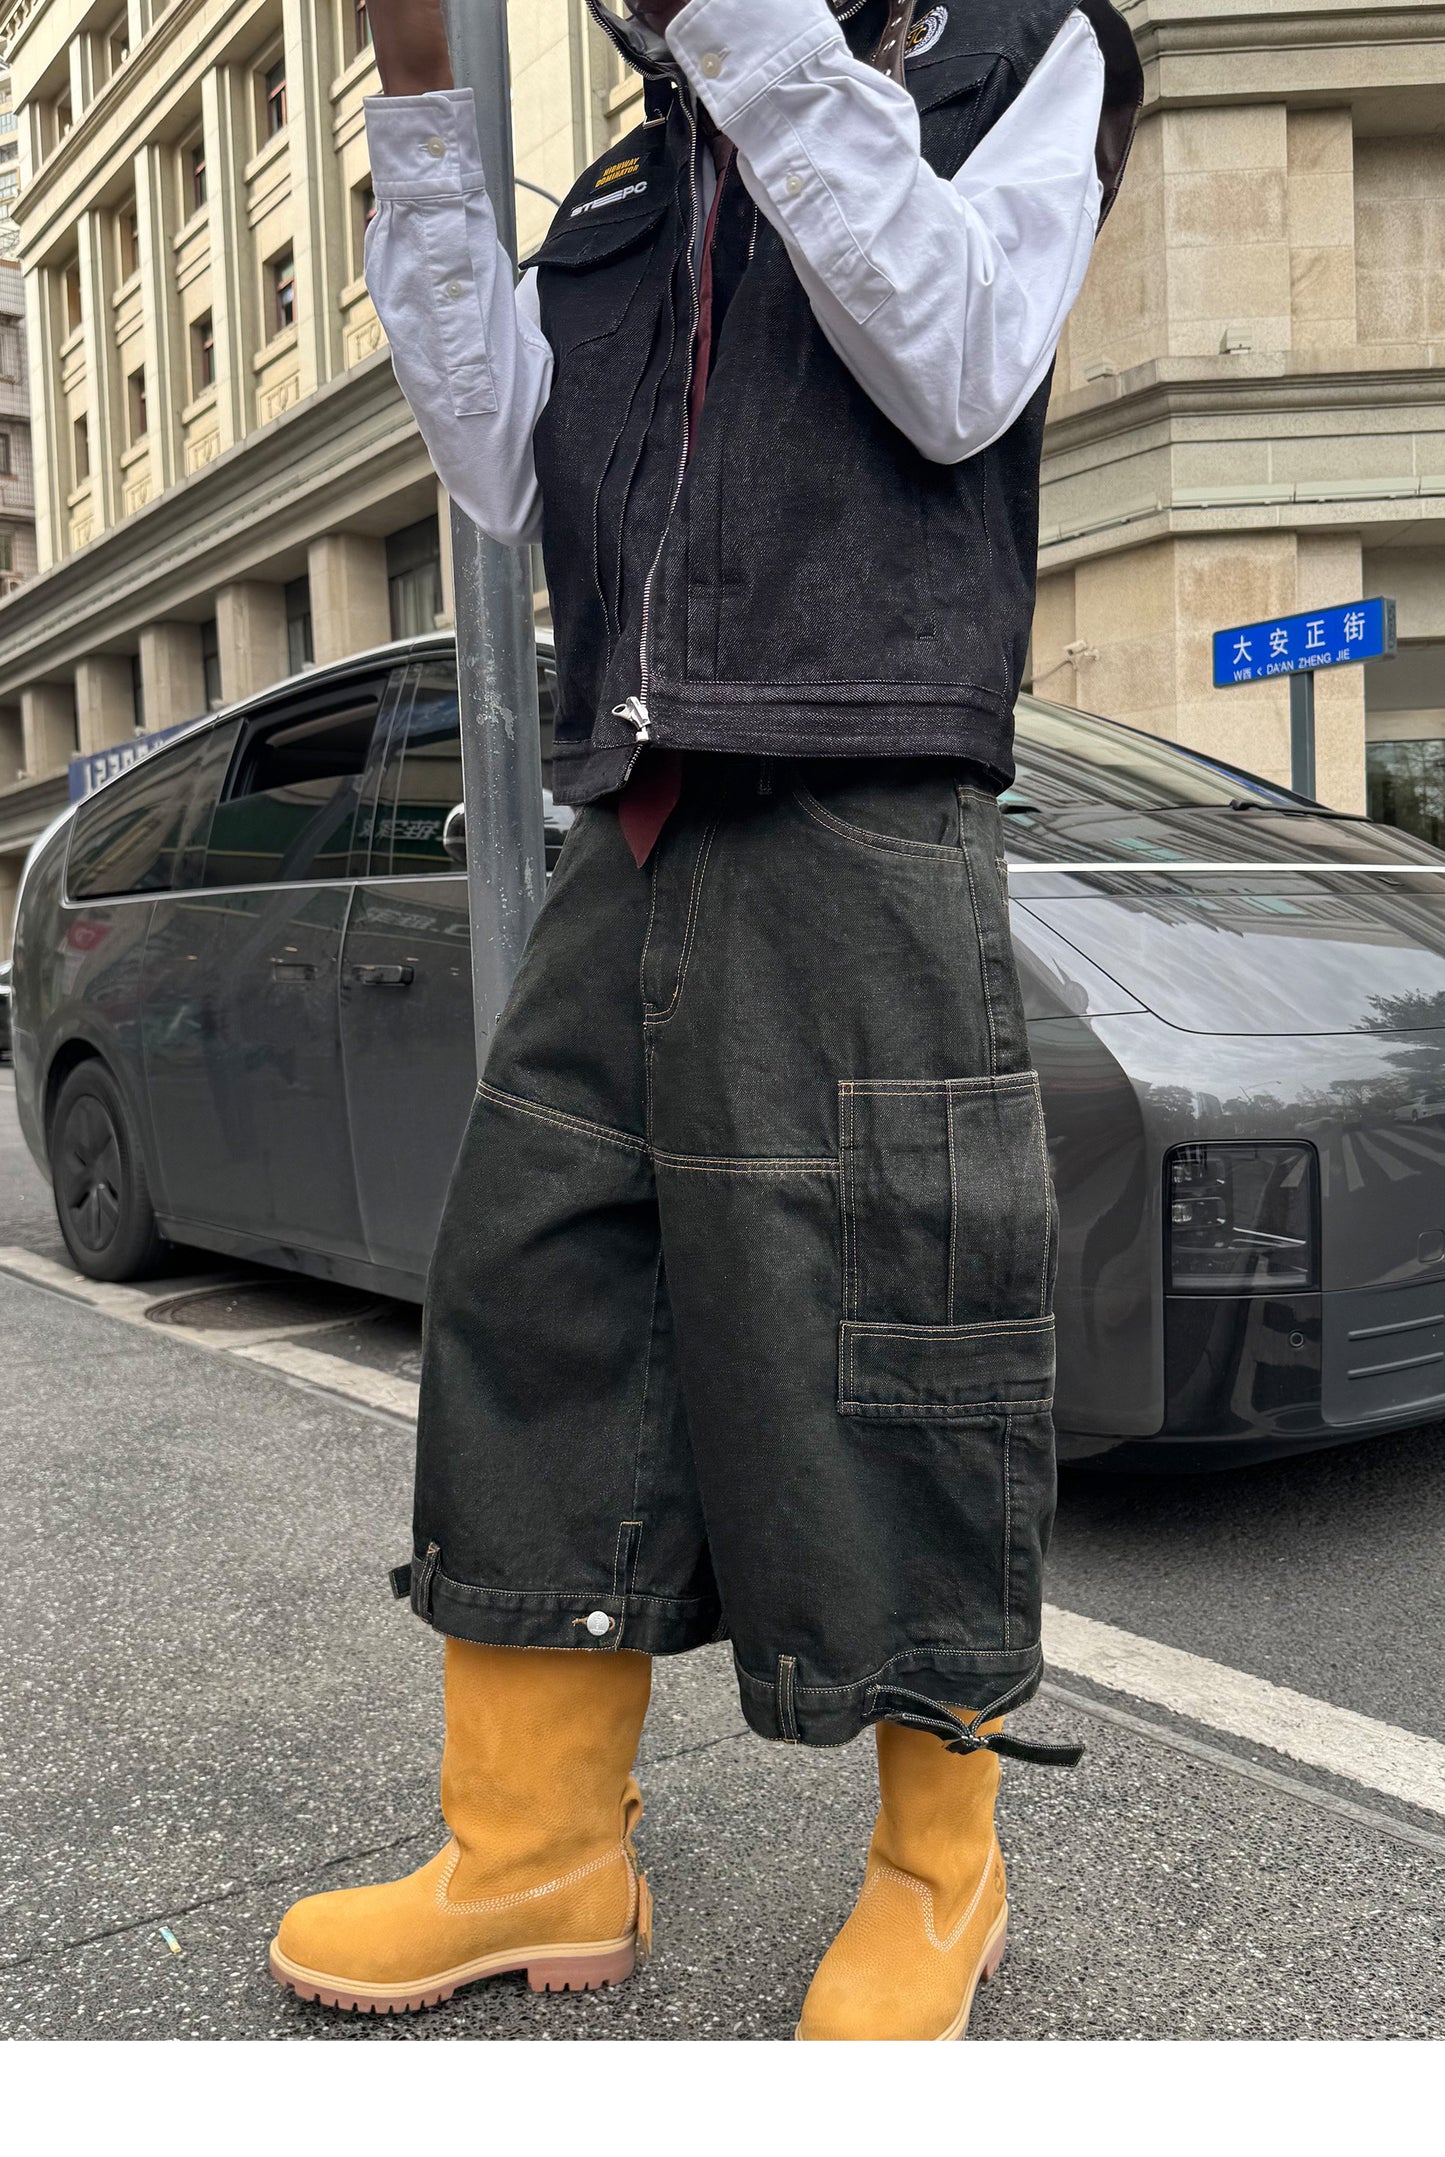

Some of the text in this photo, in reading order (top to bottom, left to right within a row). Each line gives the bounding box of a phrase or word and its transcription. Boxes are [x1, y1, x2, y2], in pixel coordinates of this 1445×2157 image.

[1232, 612, 1366, 665] 大安正街
[1298, 652, 1332, 669] ZHENG
[1336, 648, 1351, 662] JIE
